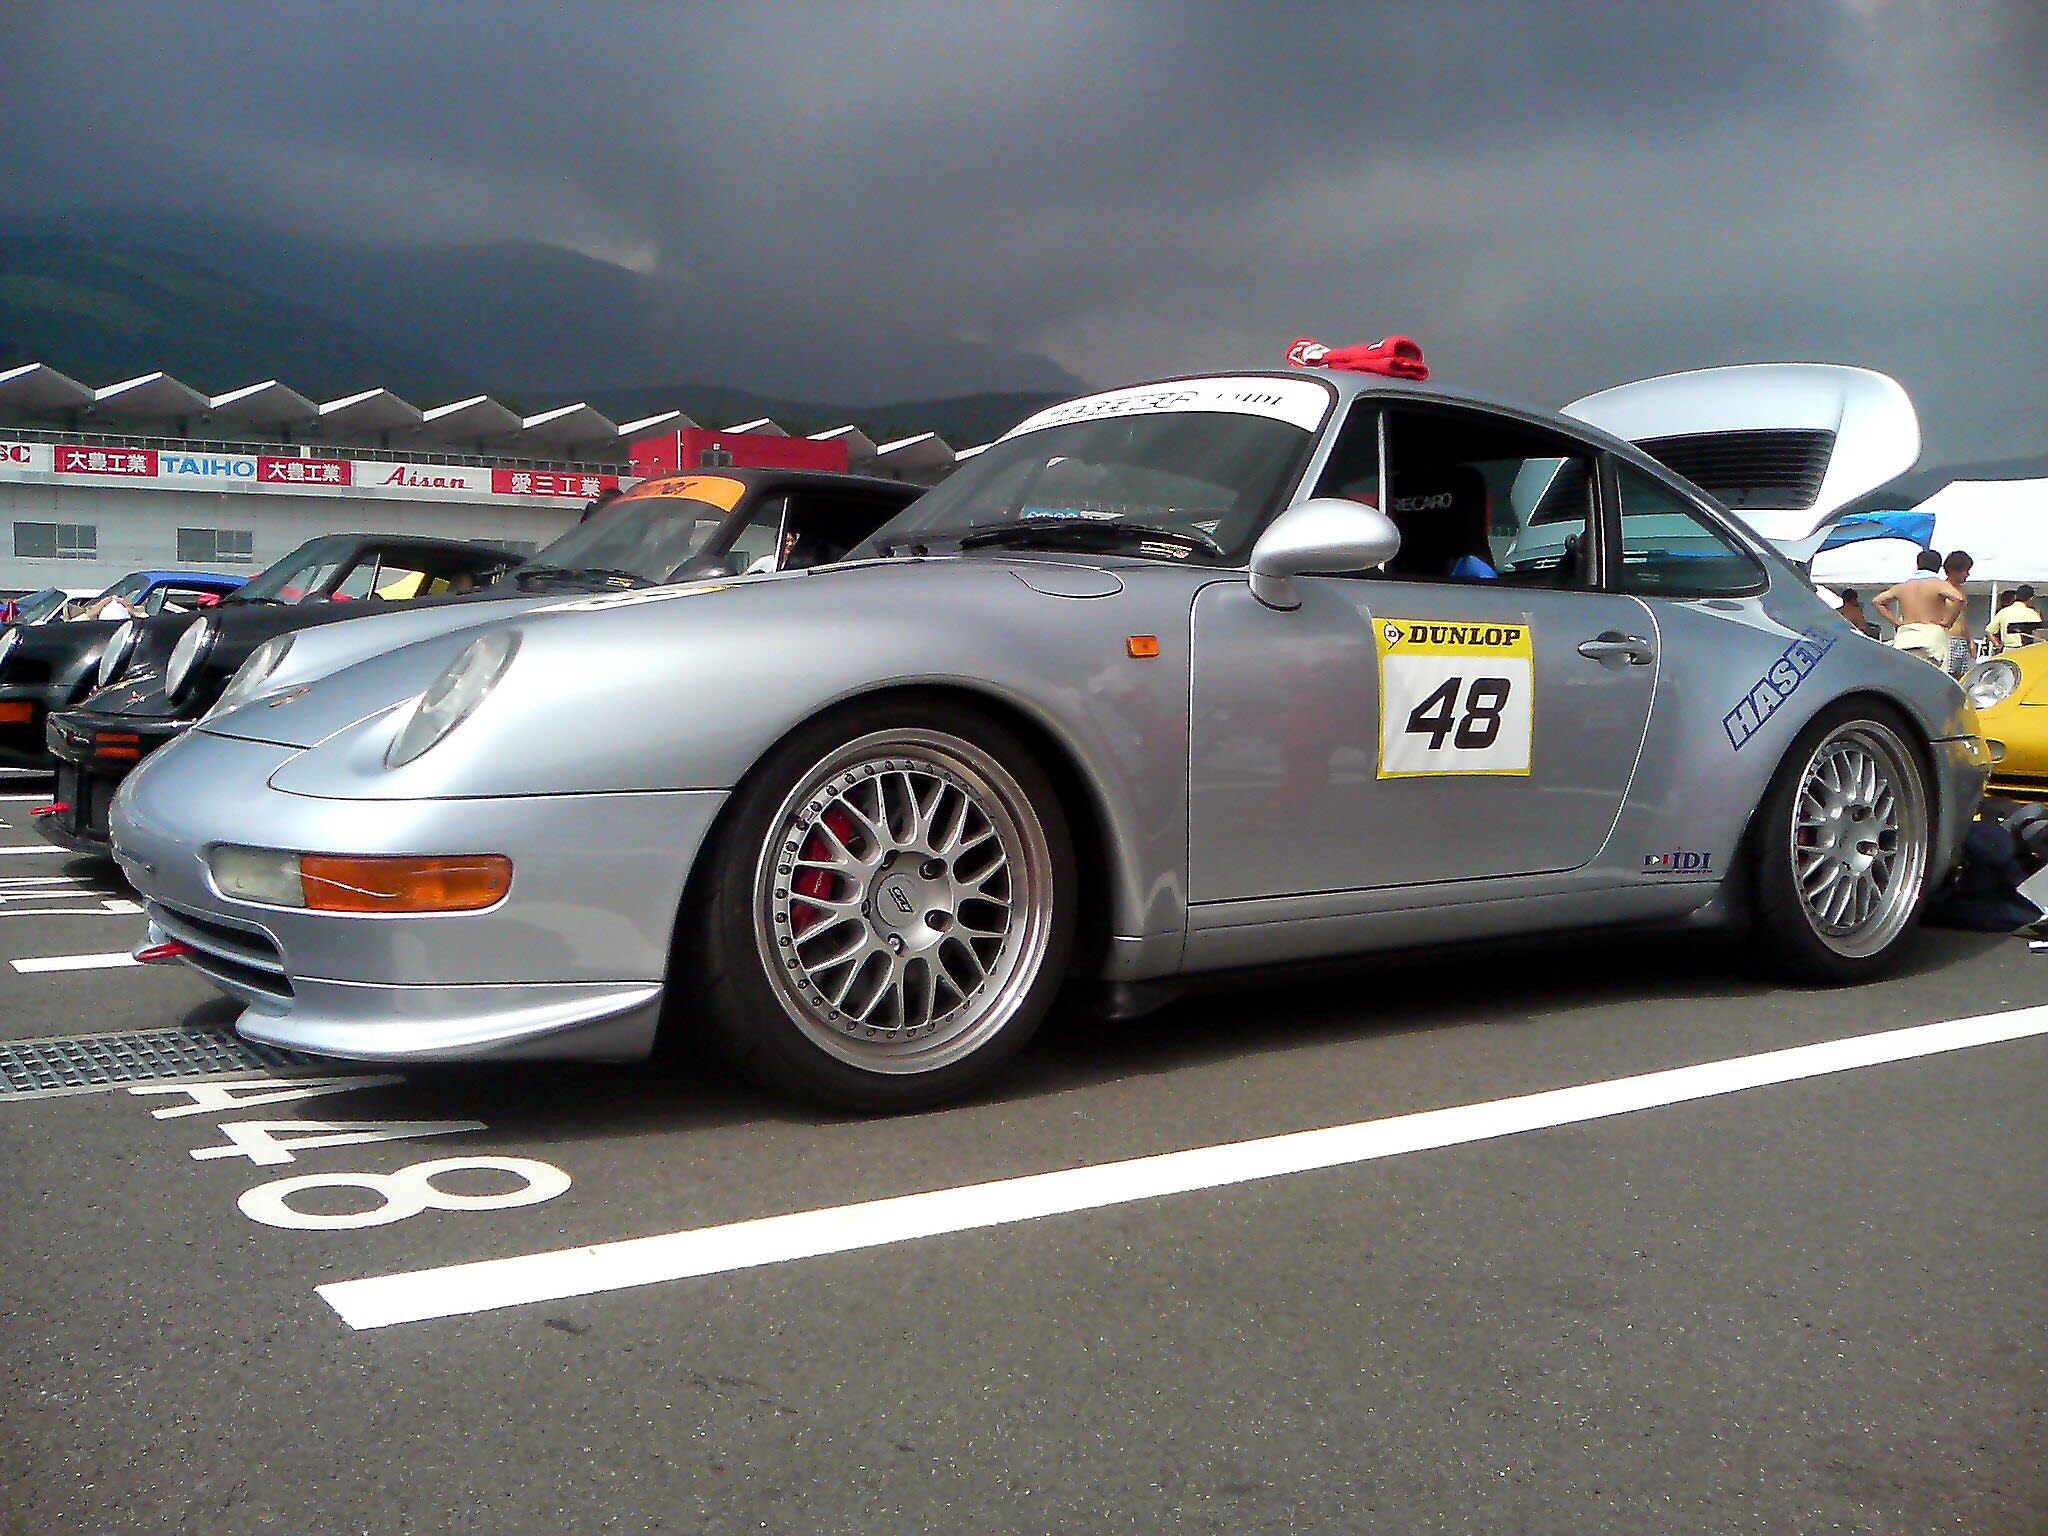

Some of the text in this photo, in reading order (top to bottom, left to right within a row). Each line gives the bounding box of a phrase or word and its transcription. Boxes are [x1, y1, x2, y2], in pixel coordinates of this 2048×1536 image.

[66, 450, 148, 474] 大豊工業
[160, 456, 256, 478] TAIHO
[376, 465, 475, 490] Aisan
[511, 472, 600, 498] 愛三工業
[1407, 625, 1521, 647] DUNLOP
[1404, 676, 1512, 751] 48
